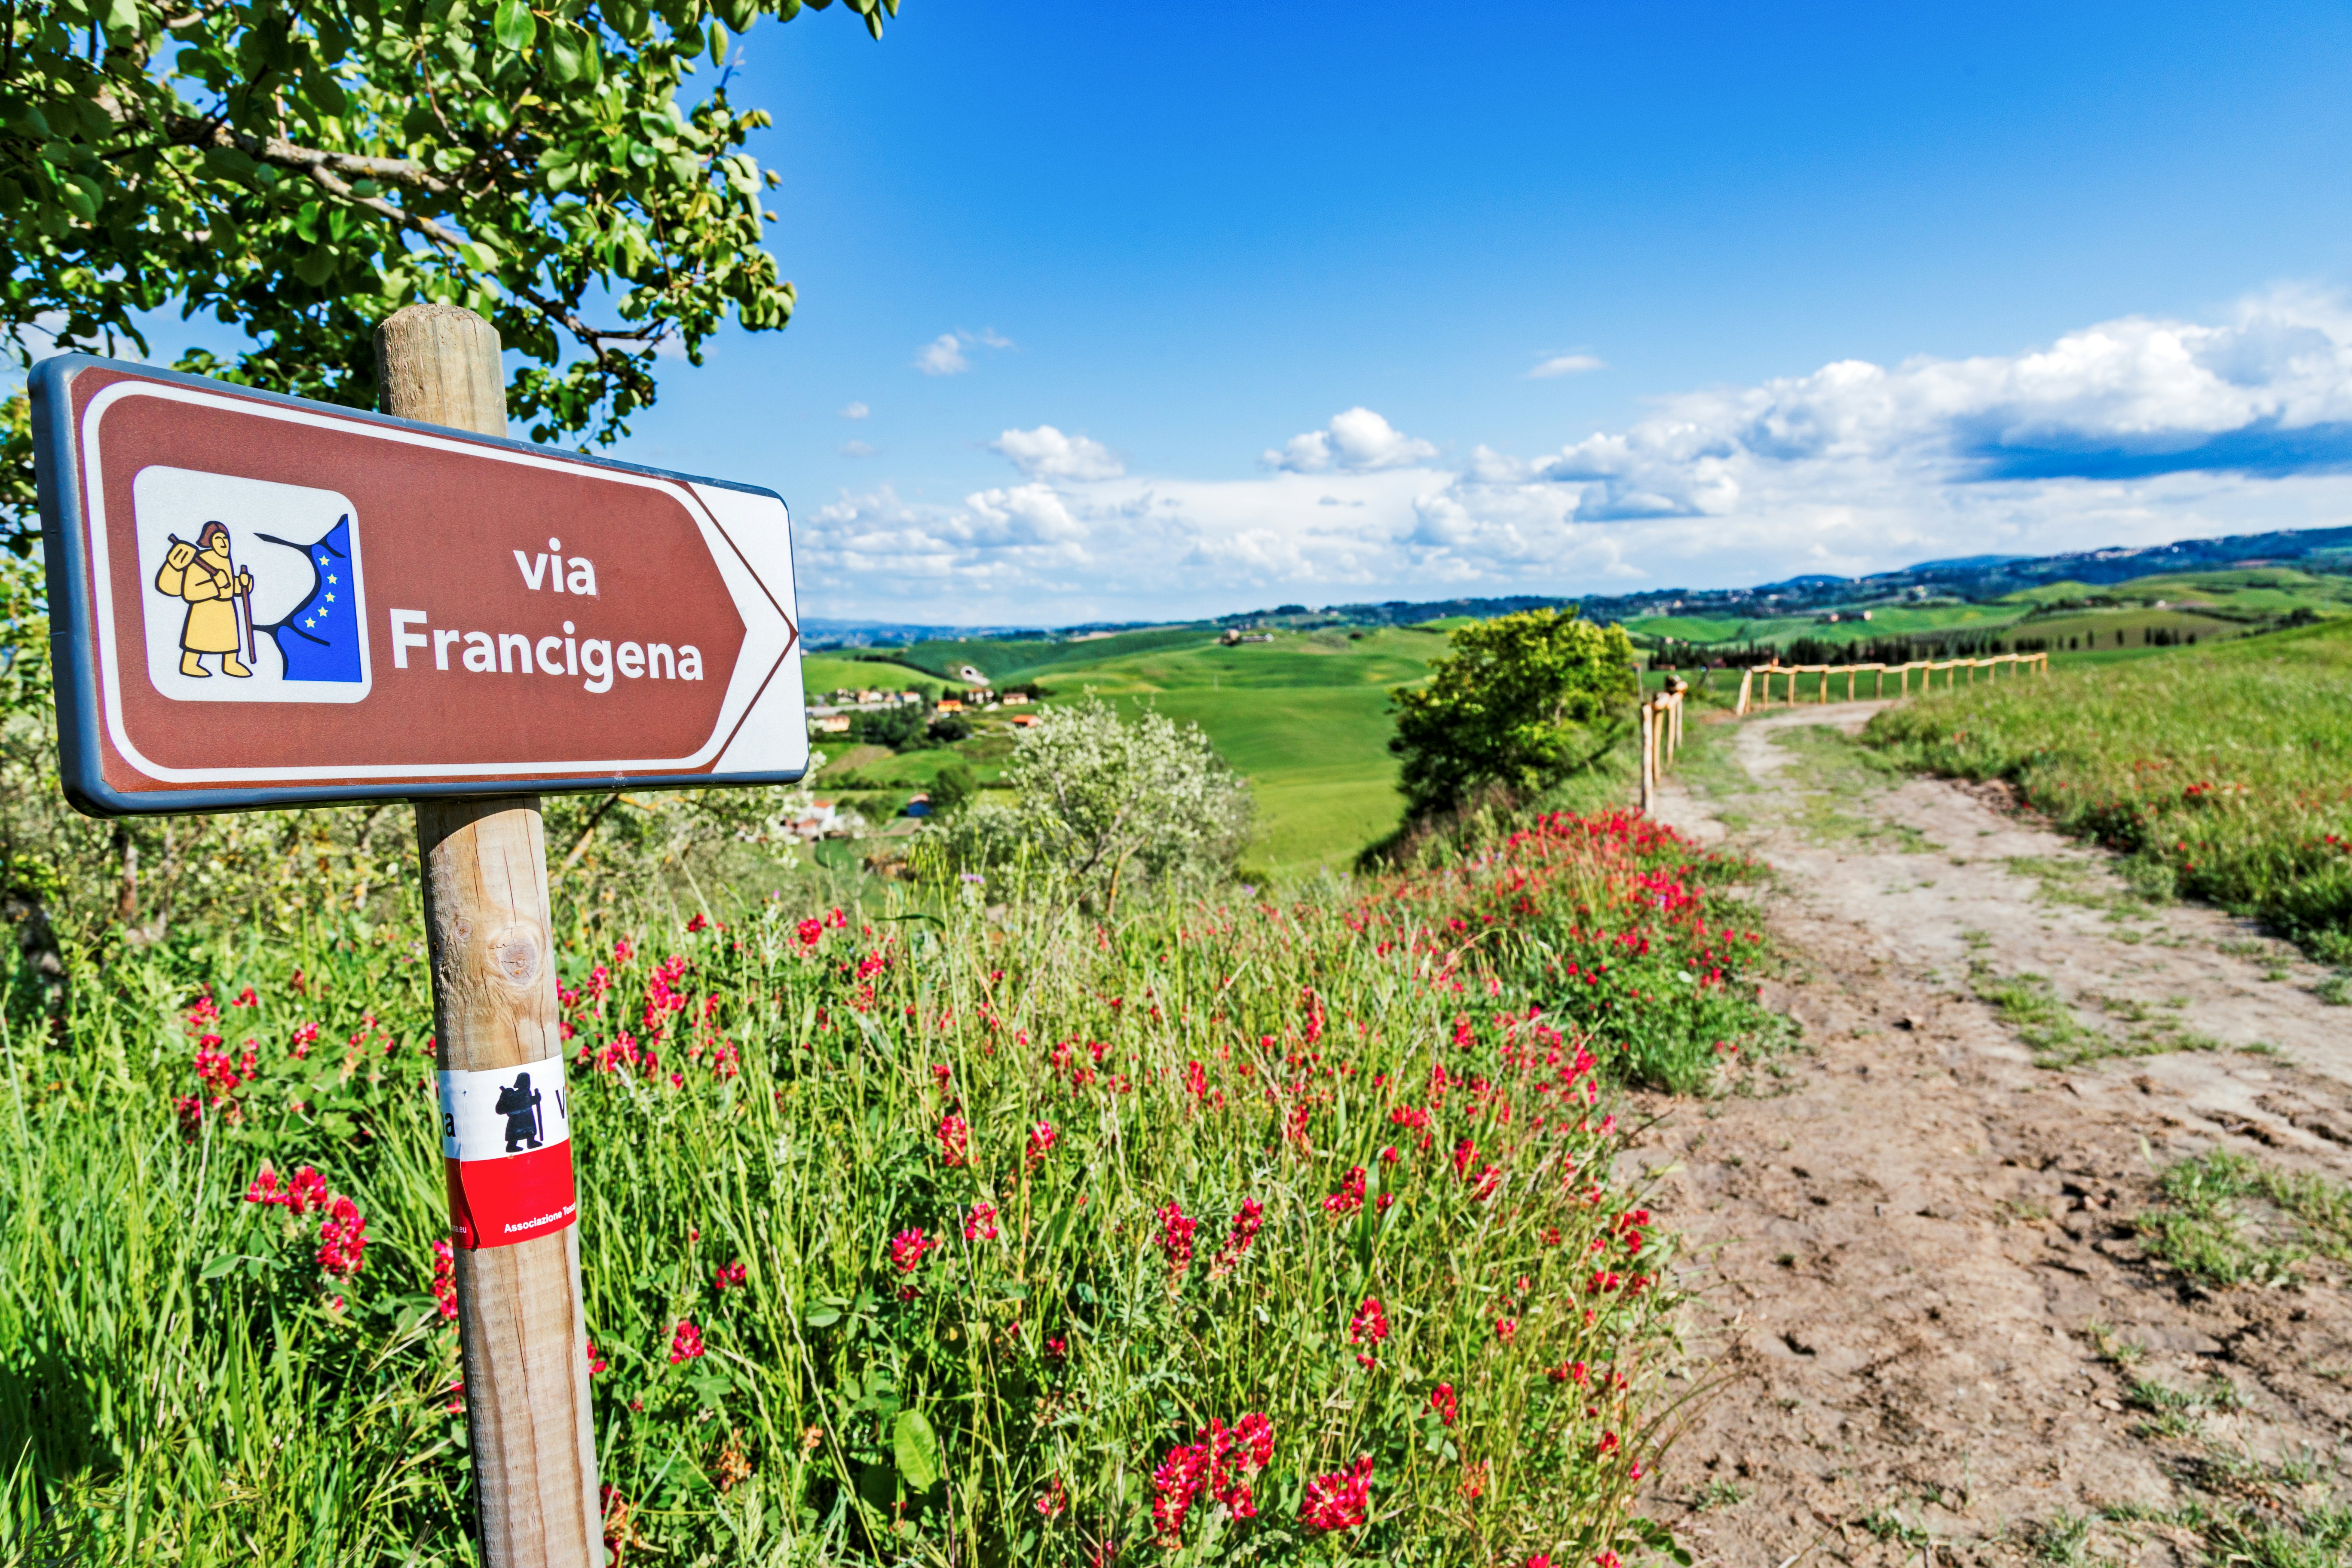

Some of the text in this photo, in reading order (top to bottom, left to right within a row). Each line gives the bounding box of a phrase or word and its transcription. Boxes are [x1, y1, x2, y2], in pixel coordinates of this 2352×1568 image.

[513, 537, 598, 596] via
[390, 608, 704, 694] Francigena
[504, 1211, 562, 1233] Associazione
